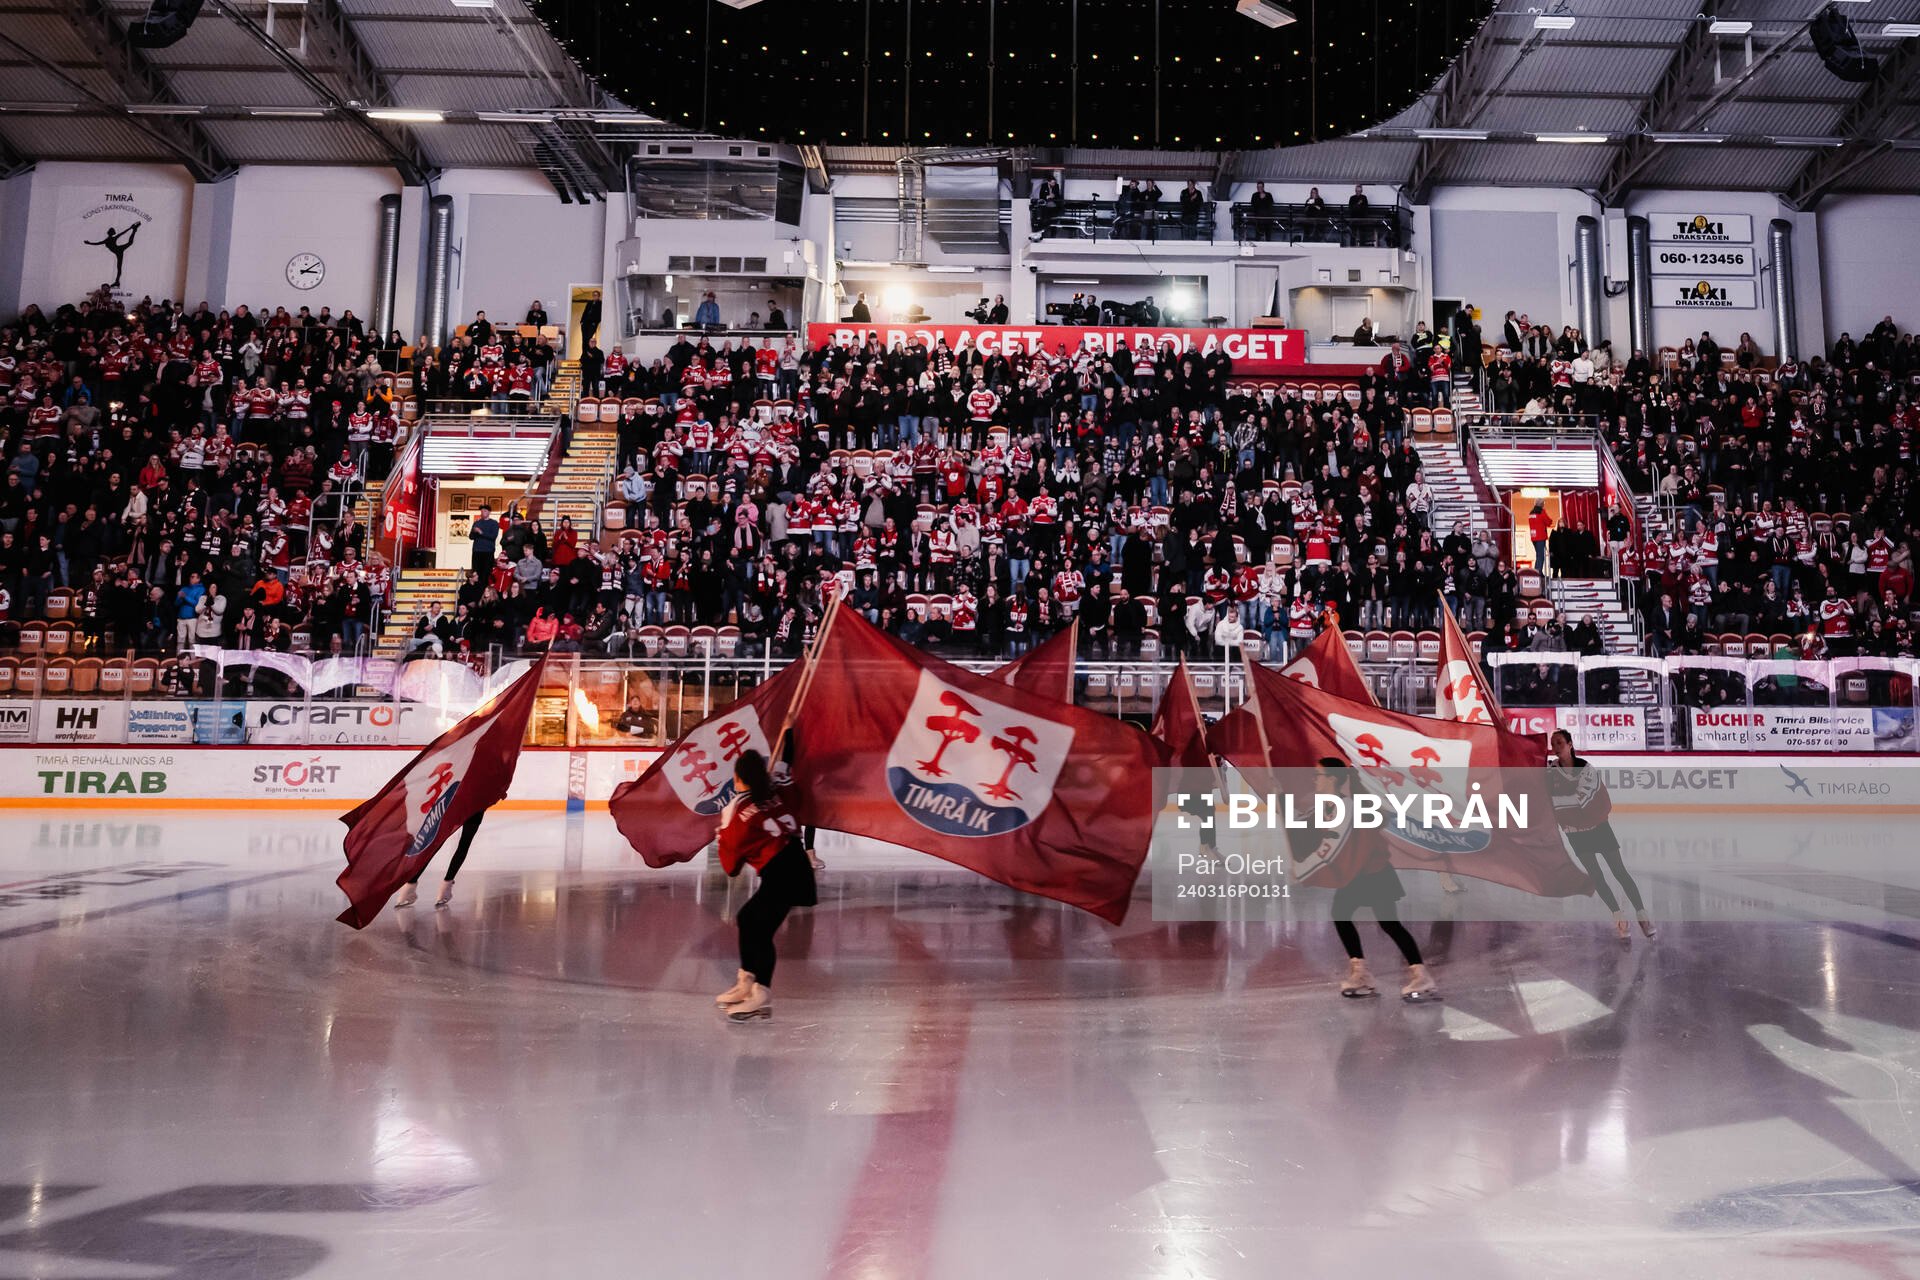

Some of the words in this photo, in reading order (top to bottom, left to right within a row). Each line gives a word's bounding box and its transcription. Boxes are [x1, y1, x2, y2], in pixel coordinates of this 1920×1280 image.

[105, 194, 134, 202] TIMRÅ
[1677, 222, 1723, 234] TAXI
[1660, 253, 1744, 264] 060-123456
[1680, 287, 1726, 300] TAXI
[35, 755, 69, 765] TIMRÅ
[71, 755, 156, 766] RENHÅLLNINGS
[158, 756, 174, 765] AB
[37, 771, 167, 794] TIRAB
[1818, 782, 1890, 795] TIMRÅBO
[903, 783, 967, 824] TIMRÅ
[968, 810, 995, 832] IK
